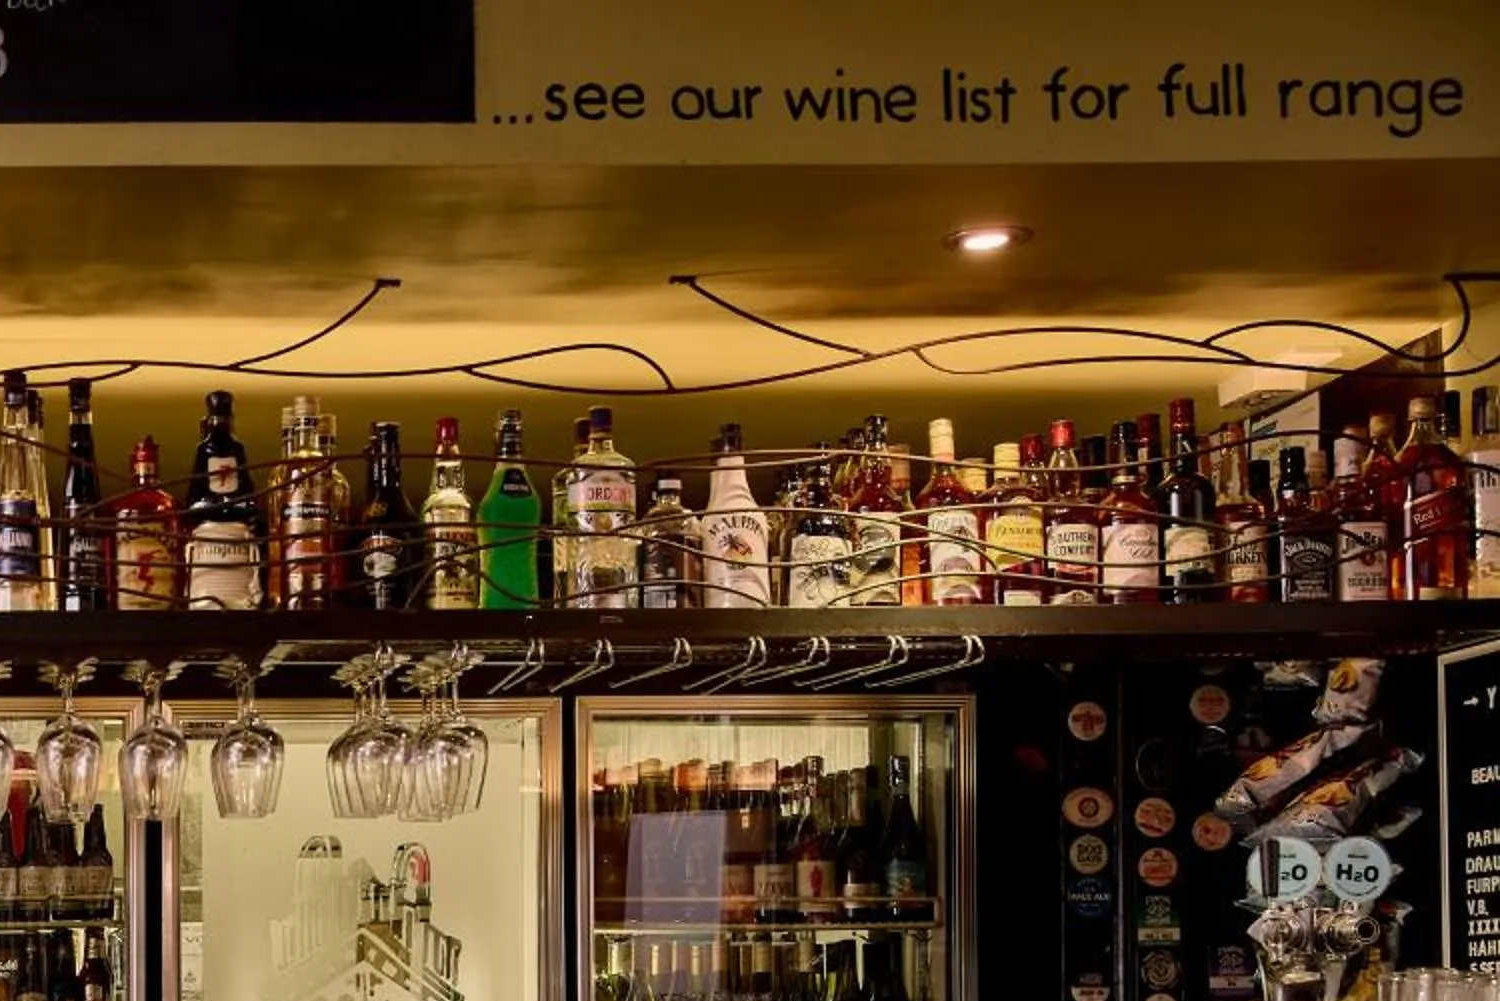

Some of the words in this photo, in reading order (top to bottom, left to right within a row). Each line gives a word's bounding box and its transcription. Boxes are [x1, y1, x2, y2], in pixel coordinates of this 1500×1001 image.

[672, 86, 763, 121] our
[785, 69, 917, 123] wine
[943, 68, 1018, 123] list
[1042, 66, 1130, 122] for
[1157, 63, 1247, 118] full
[1278, 78, 1464, 138] range
